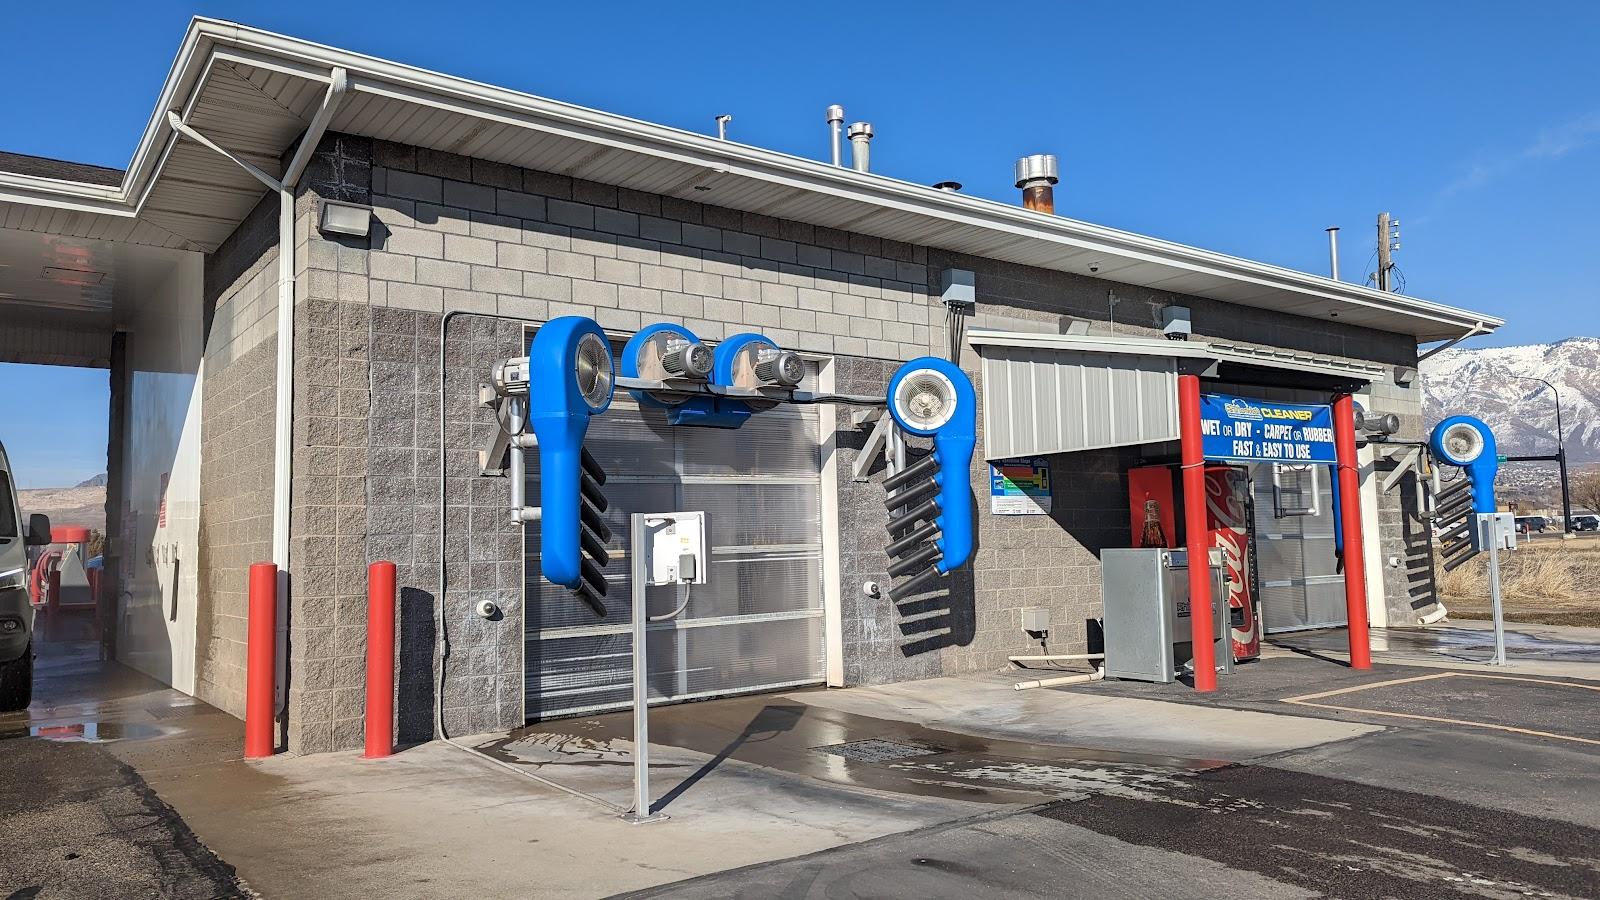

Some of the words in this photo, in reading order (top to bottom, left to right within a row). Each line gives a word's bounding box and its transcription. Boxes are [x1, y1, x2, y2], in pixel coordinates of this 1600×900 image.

[1260, 407, 1312, 421] CLEANER
[1201, 419, 1221, 436] WET
[1222, 425, 1232, 437] OR
[1234, 421, 1252, 438] DRY
[1264, 423, 1293, 441] CARPET
[1293, 430, 1302, 441] OR
[1302, 426, 1333, 443] RUBBER
[1232, 440, 1253, 457] FAST
[1255, 444, 1261, 457] &
[1262, 442, 1282, 458] EASY
[1283, 443, 1294, 459] TO
[1295, 444, 1311, 459] USE
